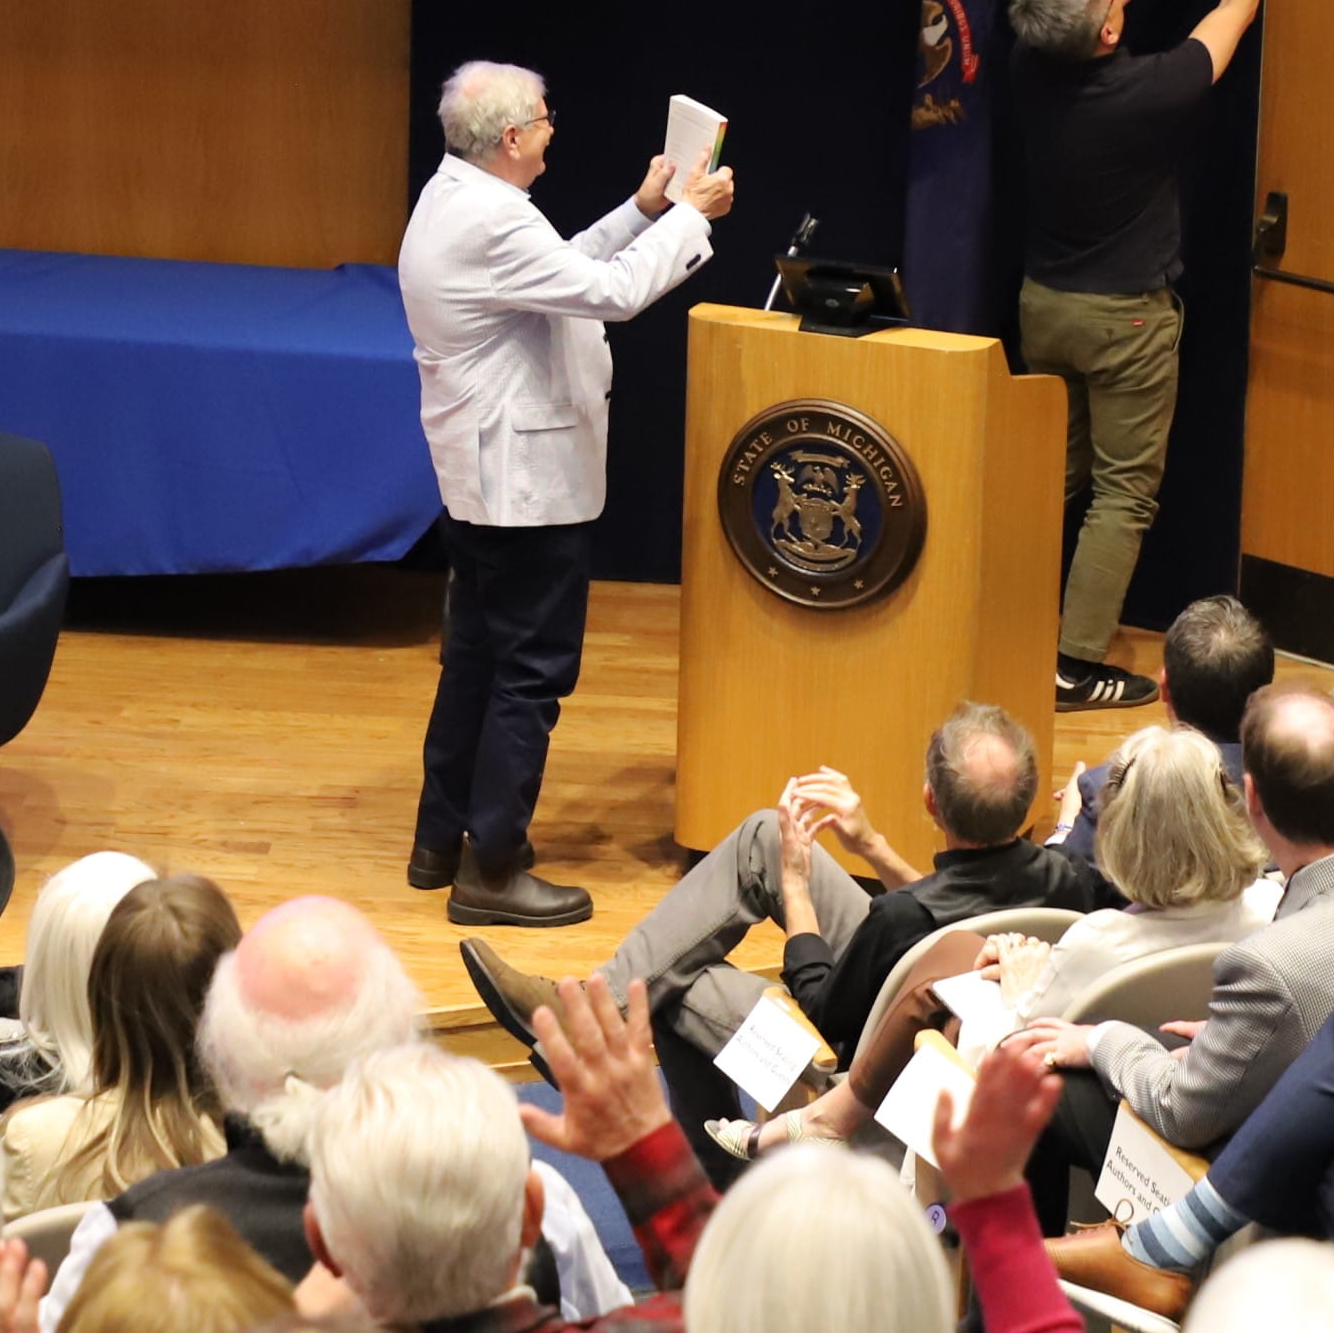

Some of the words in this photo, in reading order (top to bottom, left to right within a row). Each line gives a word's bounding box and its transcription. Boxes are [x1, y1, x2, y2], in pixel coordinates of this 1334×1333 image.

[733, 431, 773, 487] STATE
[786, 417, 811, 434] OF
[826, 420, 903, 508] MICHIGAN
[1106, 1158, 1136, 1196] Authors
[1136, 1192, 1152, 1211] and
[1115, 1145, 1151, 1187] Reserved
[1150, 1181, 1172, 1207] Seati
